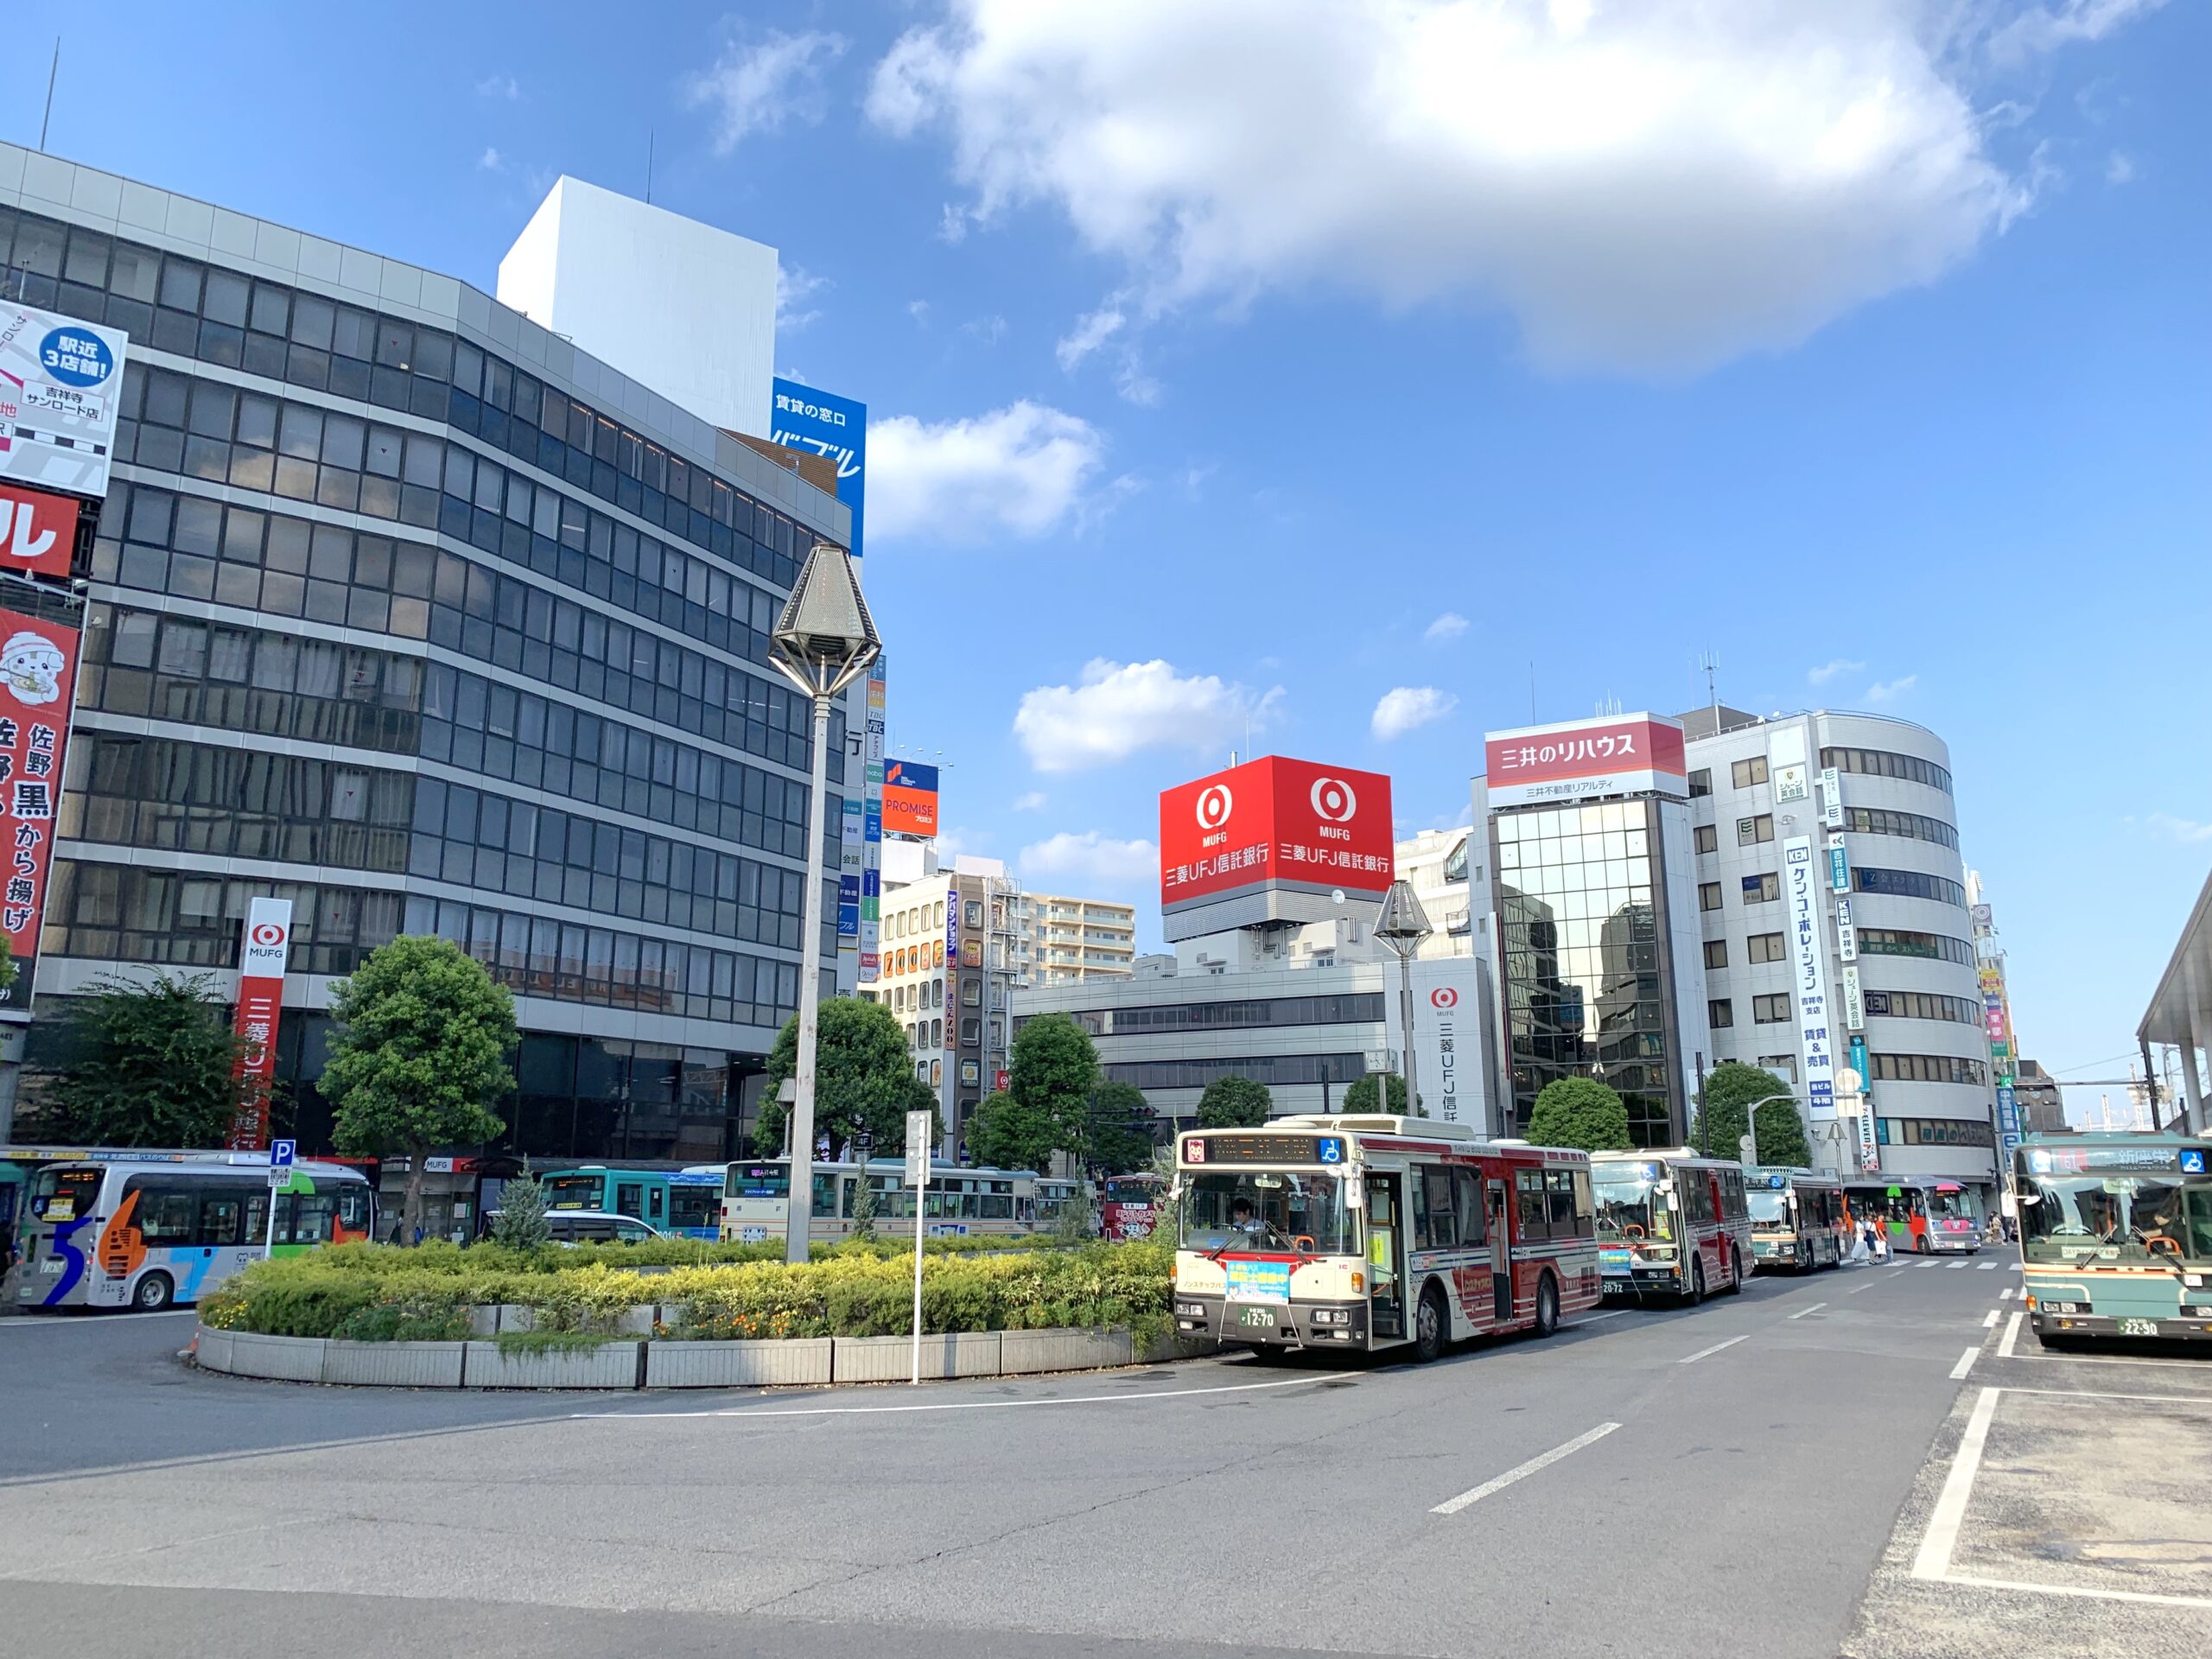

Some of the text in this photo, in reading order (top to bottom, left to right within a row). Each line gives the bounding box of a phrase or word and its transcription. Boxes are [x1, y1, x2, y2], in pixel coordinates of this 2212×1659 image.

[58, 335, 98, 359] 駅近
[43, 349, 106, 378] 3店舗!
[46, 386, 83, 404] 吉祥寺
[27, 394, 99, 419] サンロード店
[776, 394, 846, 427] 賃貸の窓口
[870, 711, 884, 720] TBC
[868, 724, 883, 734] TBC
[1502, 734, 1636, 770] 三井のリハウス
[1526, 779, 1614, 798] 三井不動産リアルティ
[886, 799, 933, 817] PROMISE
[4, 724, 54, 932] 佐野黒から揚げ
[1319, 825, 1351, 842] MUFG
[1203, 831, 1227, 848] MUFG
[1166, 842, 1269, 887] 三菱UFJ信託銀行
[1280, 842, 1389, 874] 三菱UFJ信託銀行
[1789, 849, 1808, 862] KEN
[1838, 900, 1851, 925] KEN
[948, 894, 957, 951] アパマンショップ
[1794, 868, 1815, 990] ケン・コーポレーション
[1842, 929, 1853, 957] 吉祥寺
[250, 948, 283, 958] MUFG
[1802, 995, 1823, 1006] 吉祥寺
[1806, 1006, 1821, 1015] 支店
[1804, 1028, 1827, 1041] 賃貸
[1812, 1042, 1821, 1052] &
[1807, 1054, 1830, 1067] 売買
[858, 1137, 868, 1146] 4F
[276, 1143, 290, 1163] P
